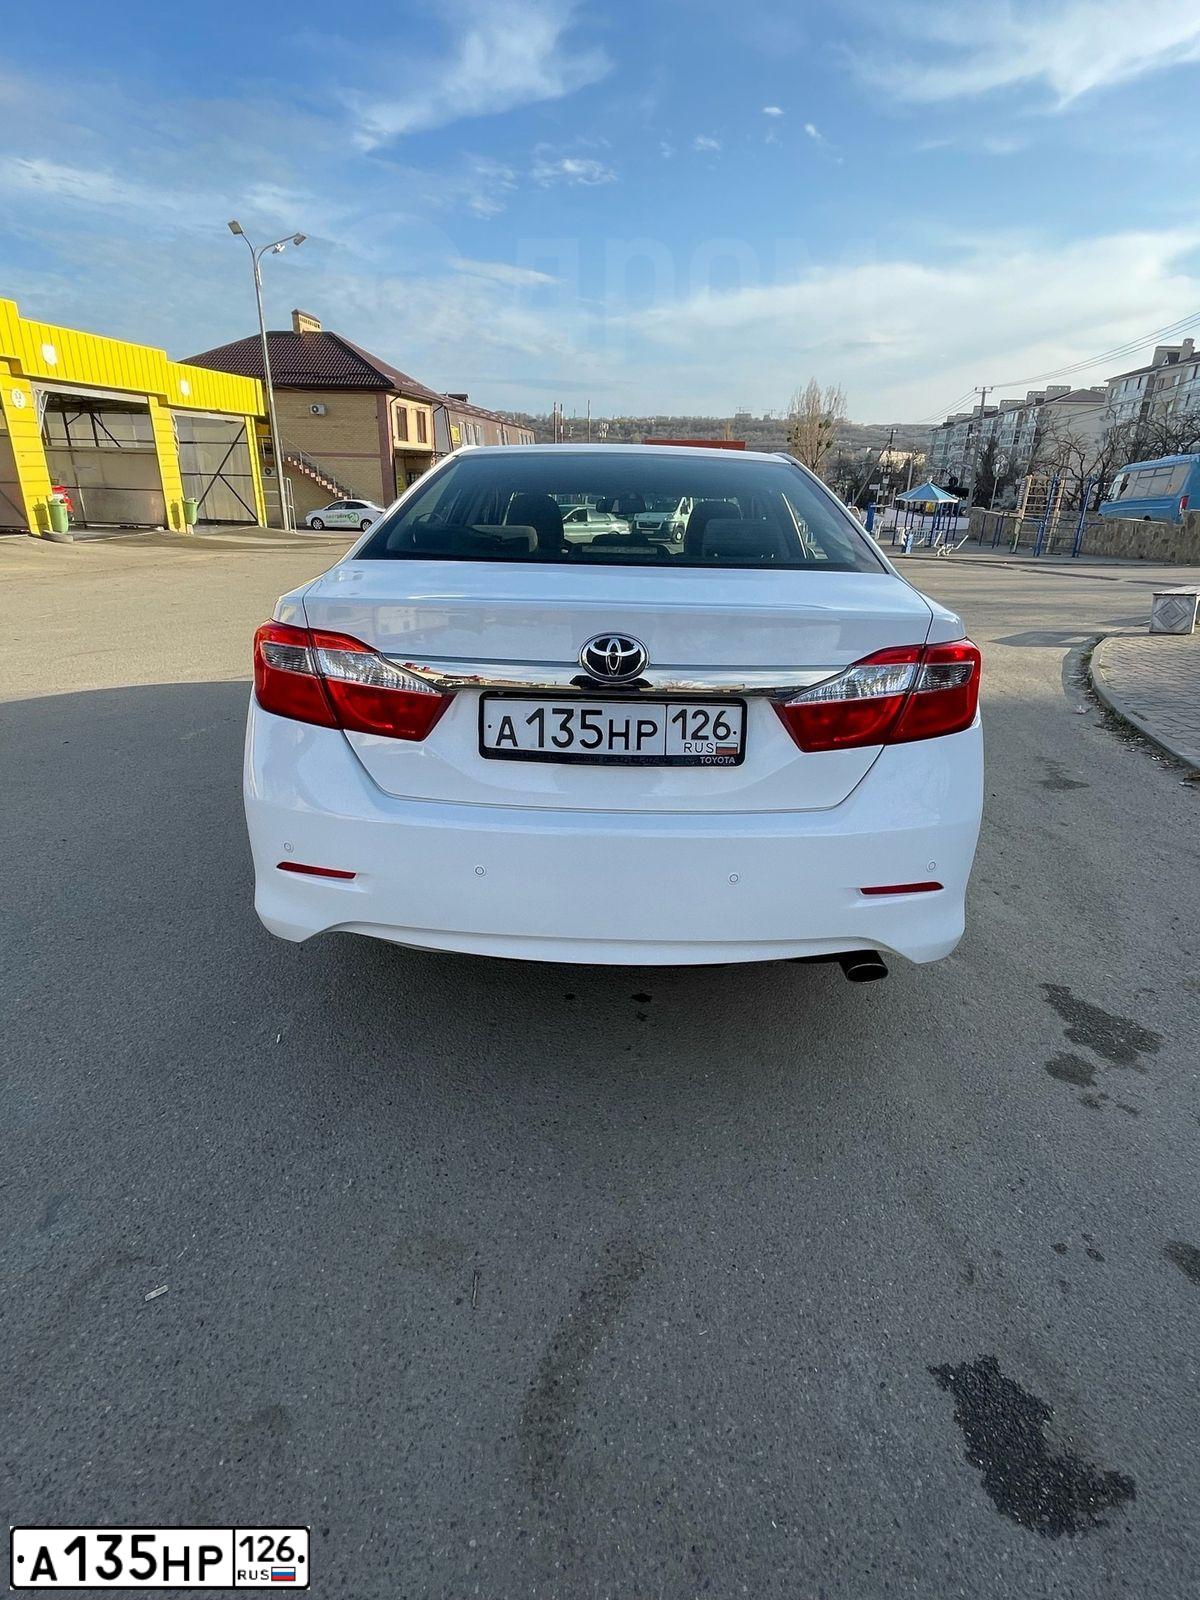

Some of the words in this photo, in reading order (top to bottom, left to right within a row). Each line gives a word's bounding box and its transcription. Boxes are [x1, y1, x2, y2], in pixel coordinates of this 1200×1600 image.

[671, 708, 731, 741] 126
[683, 742, 714, 753] RUS
[699, 756, 736, 764] TOYOTA
